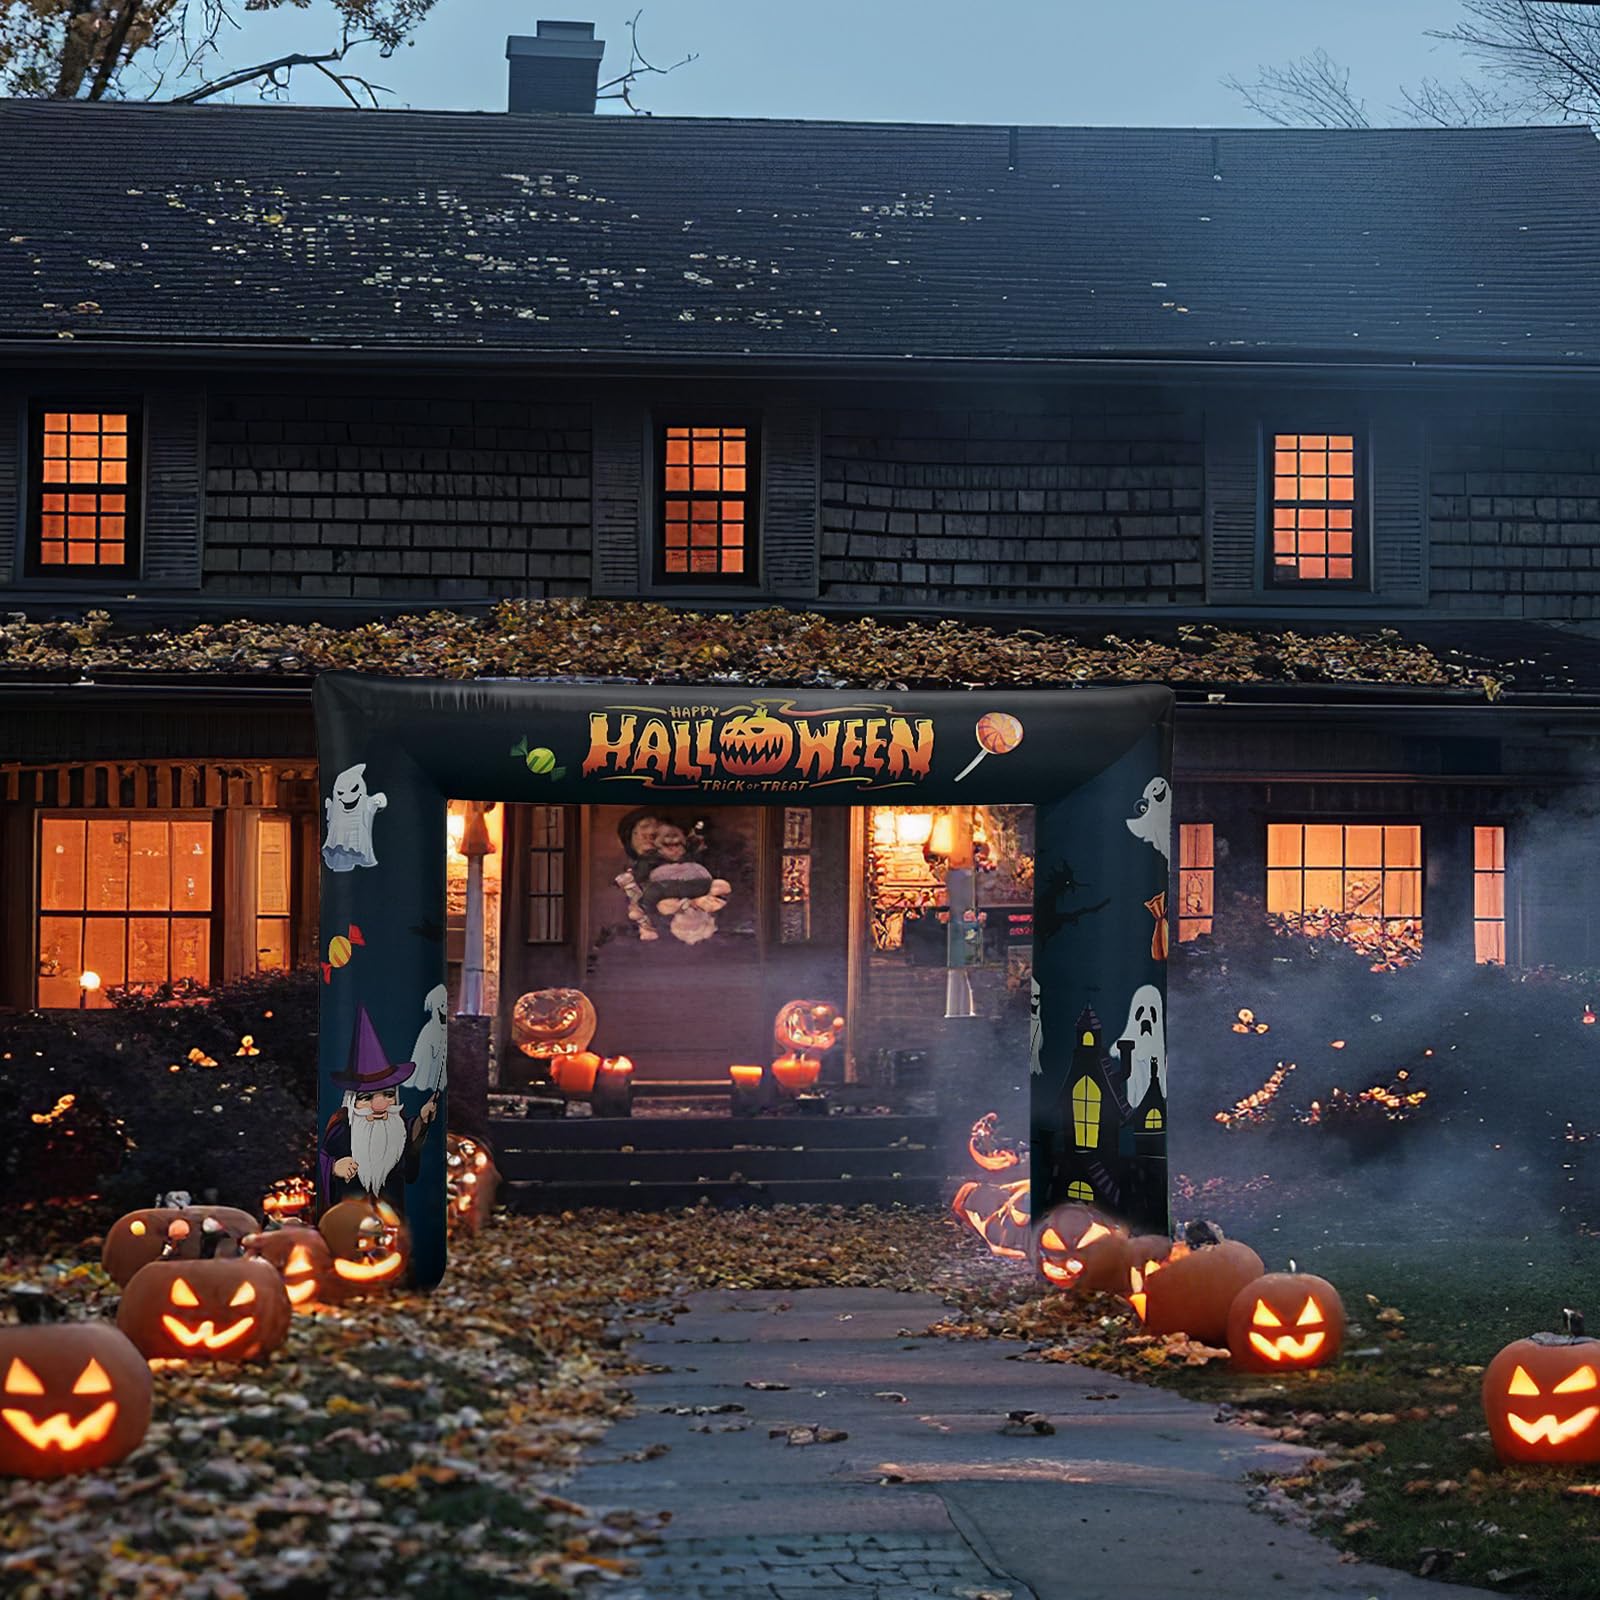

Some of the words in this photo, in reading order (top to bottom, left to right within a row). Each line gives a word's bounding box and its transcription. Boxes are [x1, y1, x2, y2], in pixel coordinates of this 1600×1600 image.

[669, 705, 720, 718] HAPPY
[582, 708, 935, 783] HALLOWEEN
[760, 780, 810, 792] TREAT
